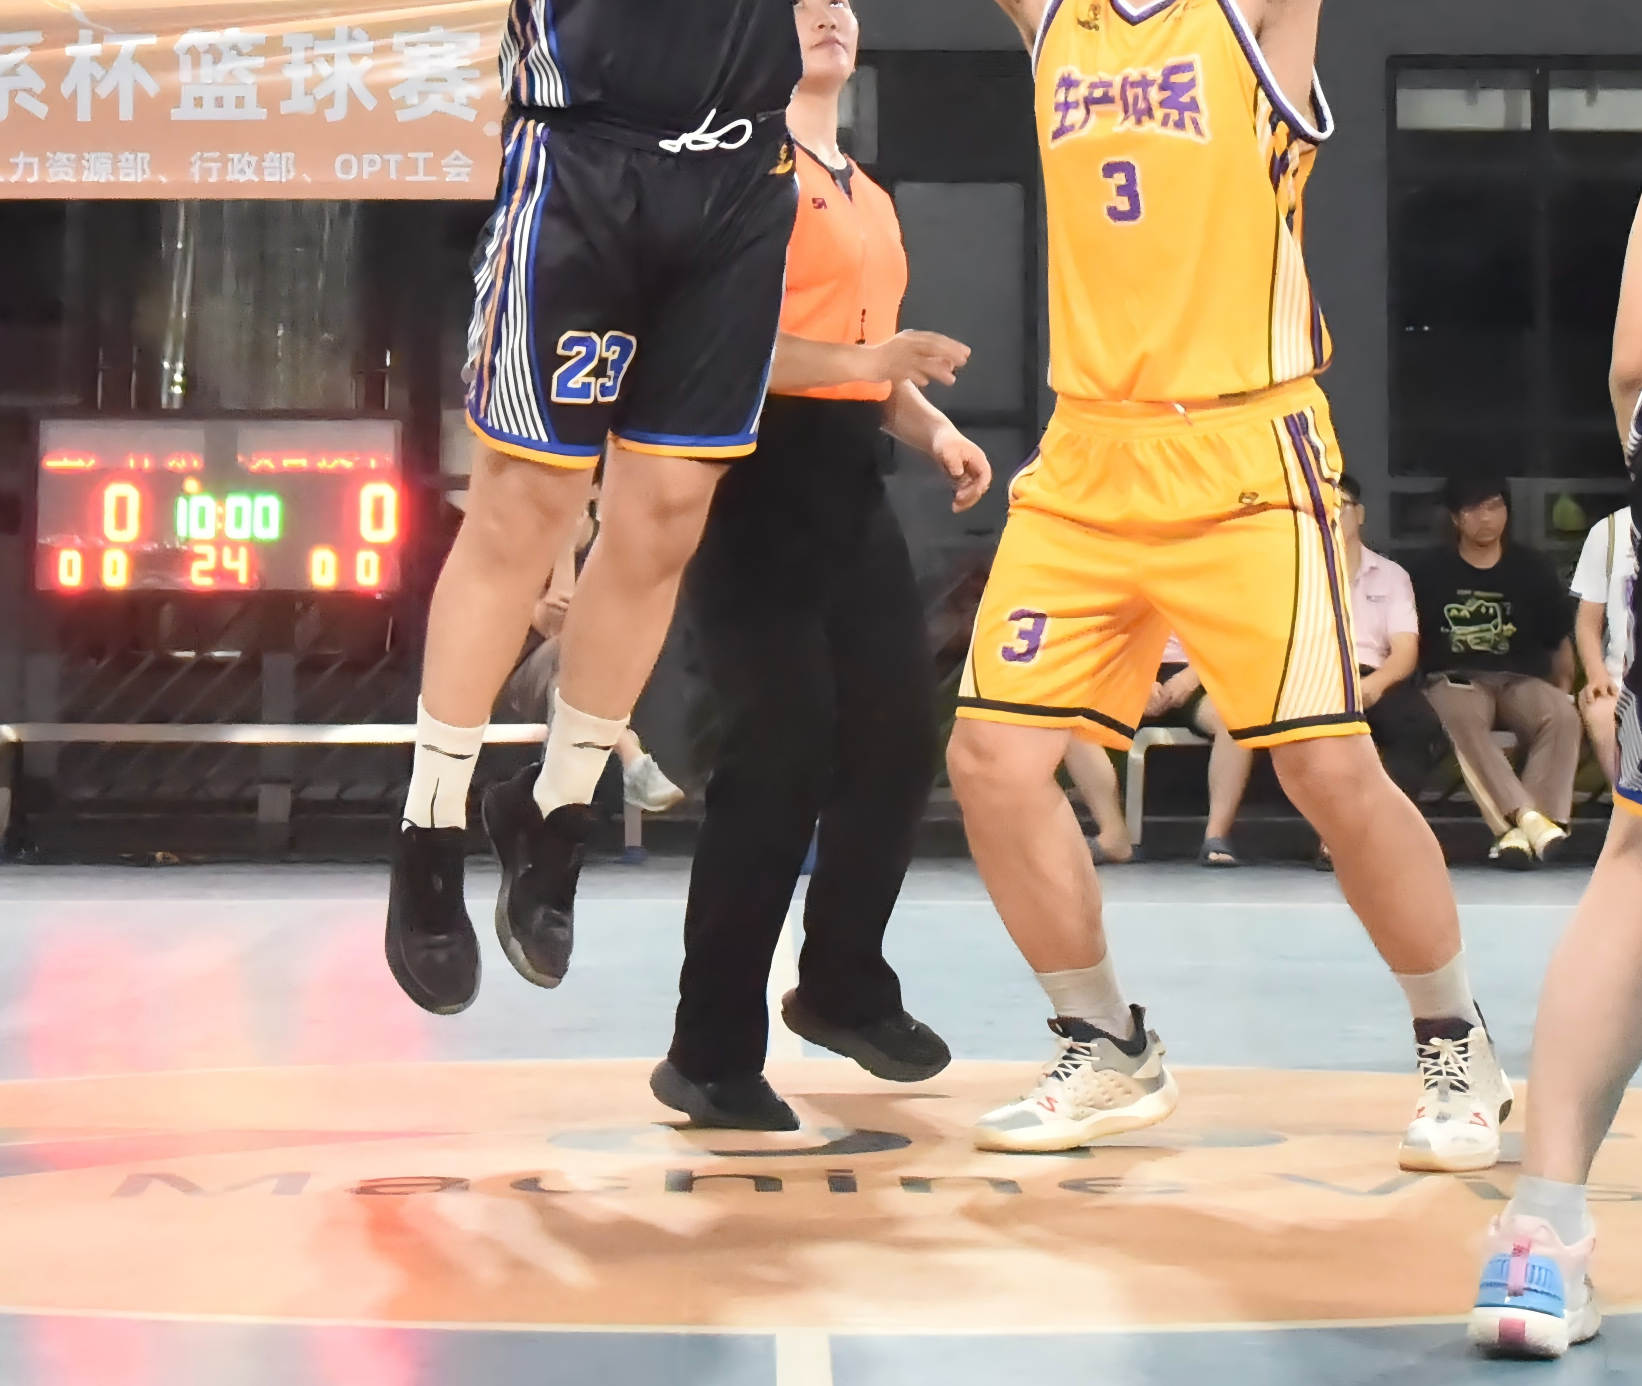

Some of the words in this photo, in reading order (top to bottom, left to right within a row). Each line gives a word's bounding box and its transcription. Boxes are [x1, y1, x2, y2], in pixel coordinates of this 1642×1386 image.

[1101, 159, 1143, 225] 3
[551, 330, 637, 404] 23
[103, 482, 141, 543] 0
[176, 493, 283, 541] 10:00
[359, 482, 398, 543] 0
[190, 544, 249, 586] 24
[1000, 608, 1048, 664] 3
[109, 1168, 1187, 1198] Machine
